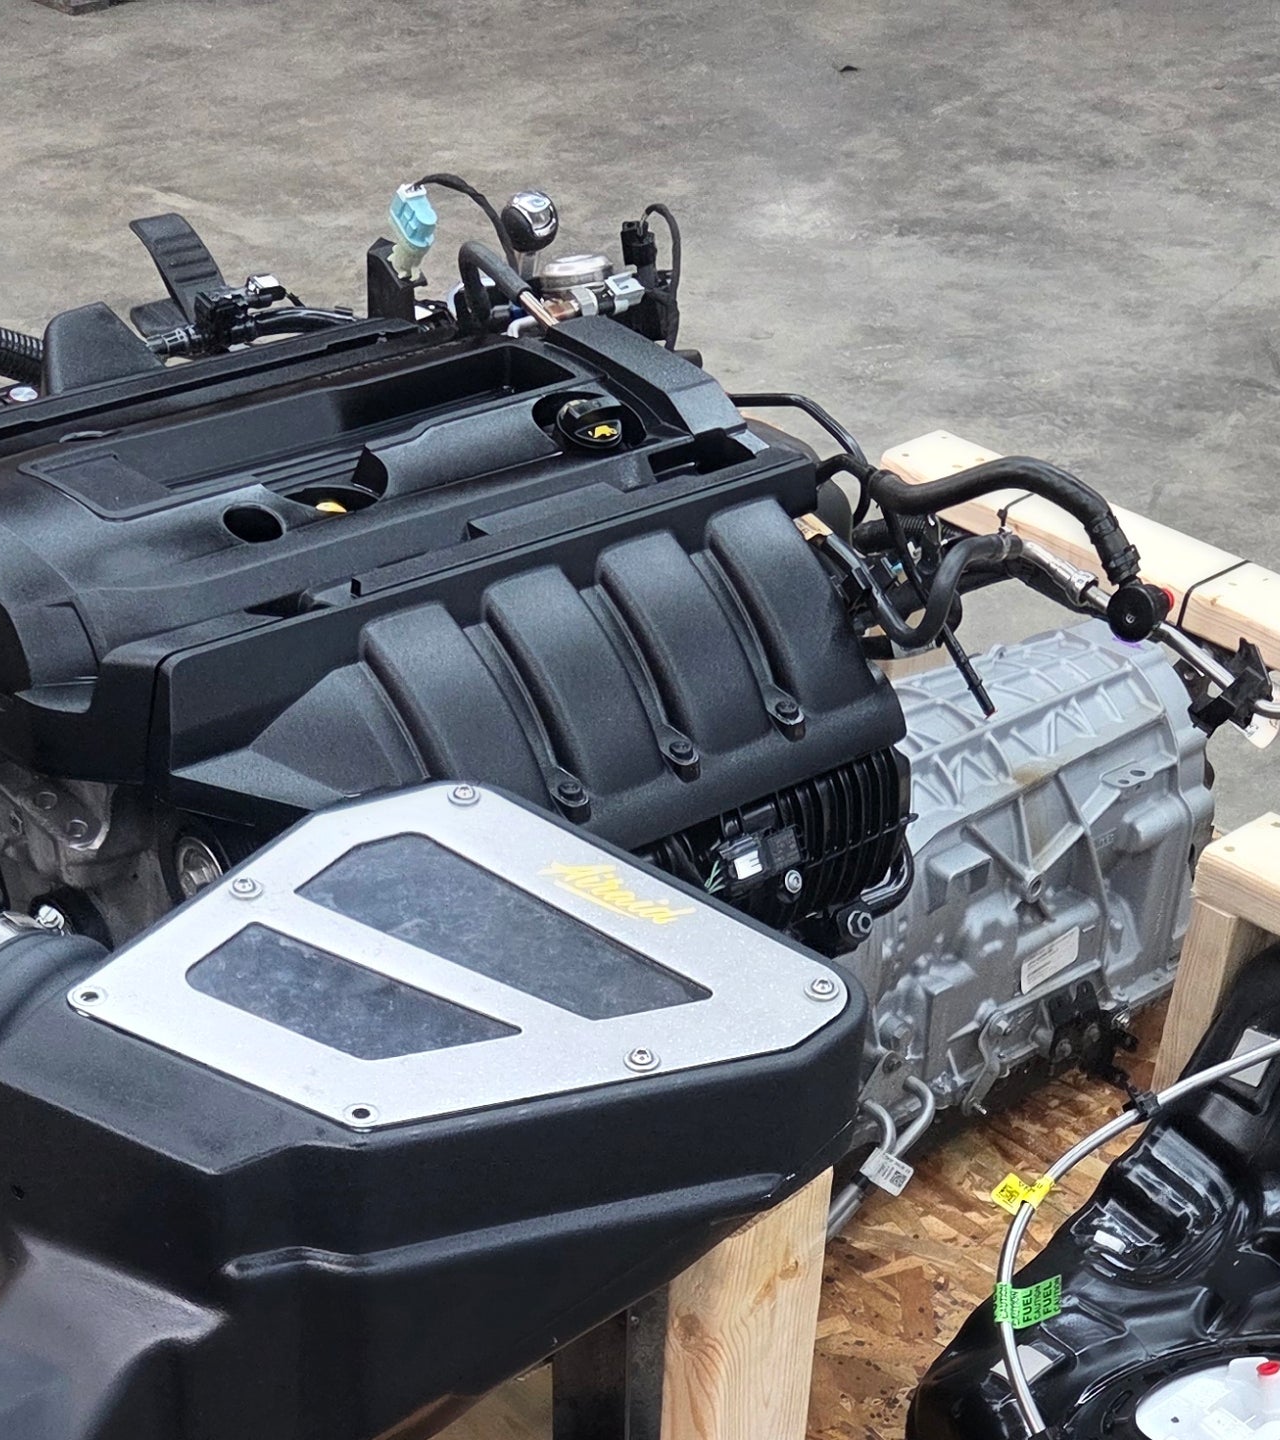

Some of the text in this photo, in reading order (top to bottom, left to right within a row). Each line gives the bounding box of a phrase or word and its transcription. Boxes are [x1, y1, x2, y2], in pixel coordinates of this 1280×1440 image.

[537, 862, 697, 925] Airaid
[1022, 1290, 1032, 1323] FUEL
[1034, 1285, 1042, 1320] CAUTION
[1043, 1281, 1052, 1315] FUEL
